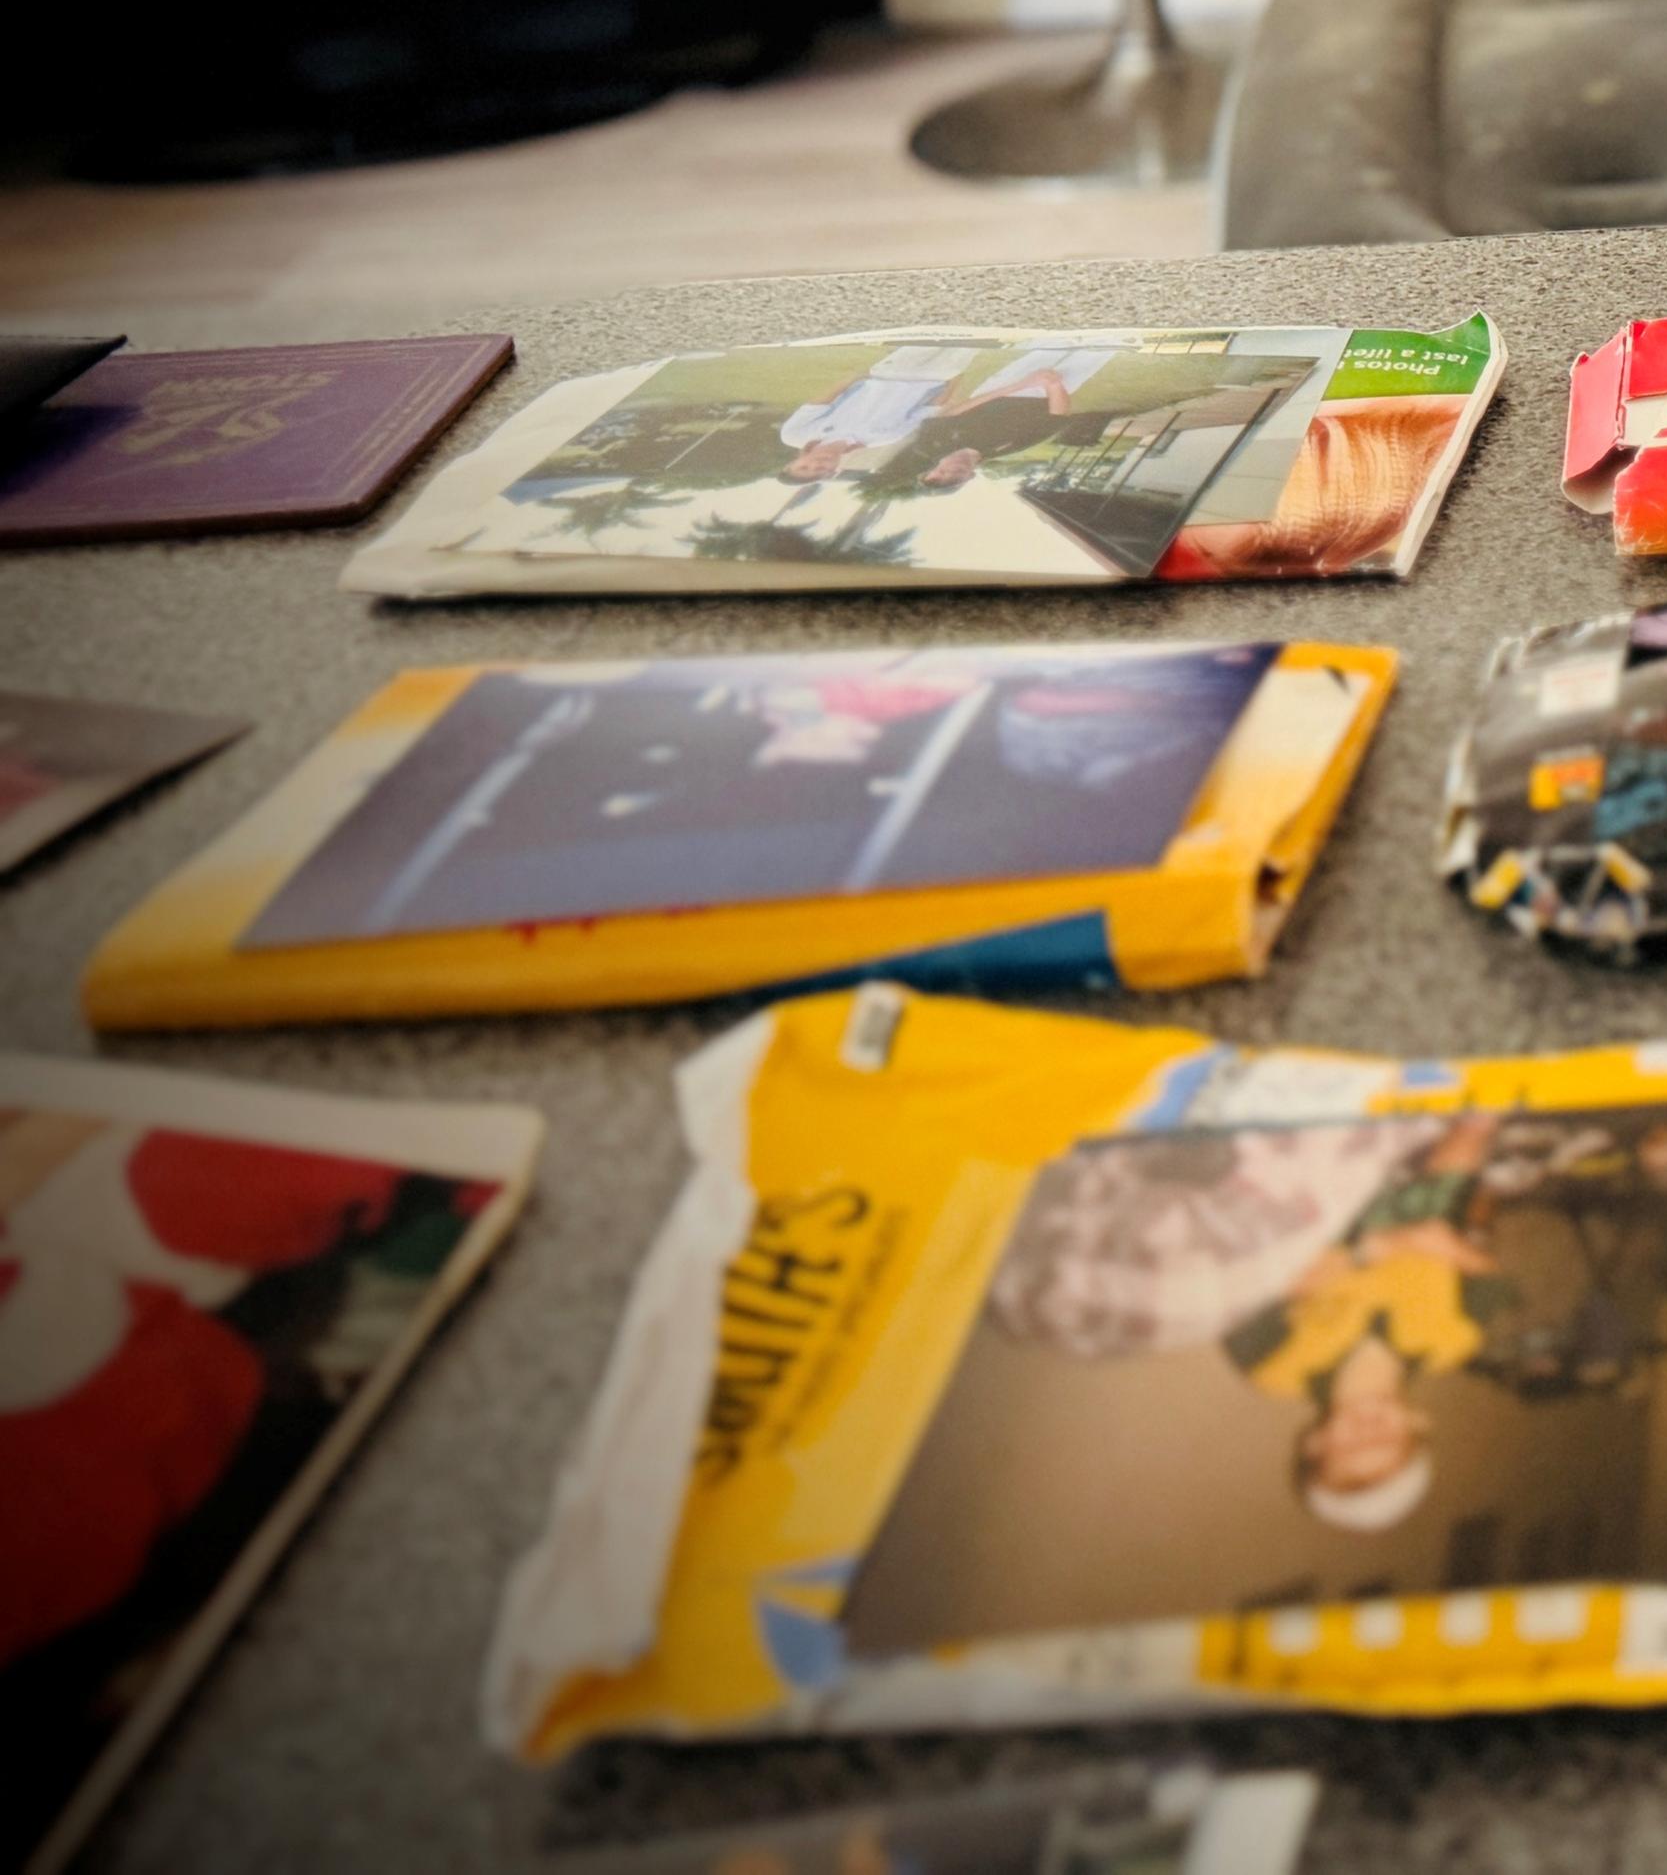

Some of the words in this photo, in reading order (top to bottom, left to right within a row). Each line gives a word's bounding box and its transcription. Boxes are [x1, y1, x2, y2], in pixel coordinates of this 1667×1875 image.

[1401, 349, 1415, 357] a
[1422, 351, 1469, 365] last
[1354, 361, 1441, 375] Photos
